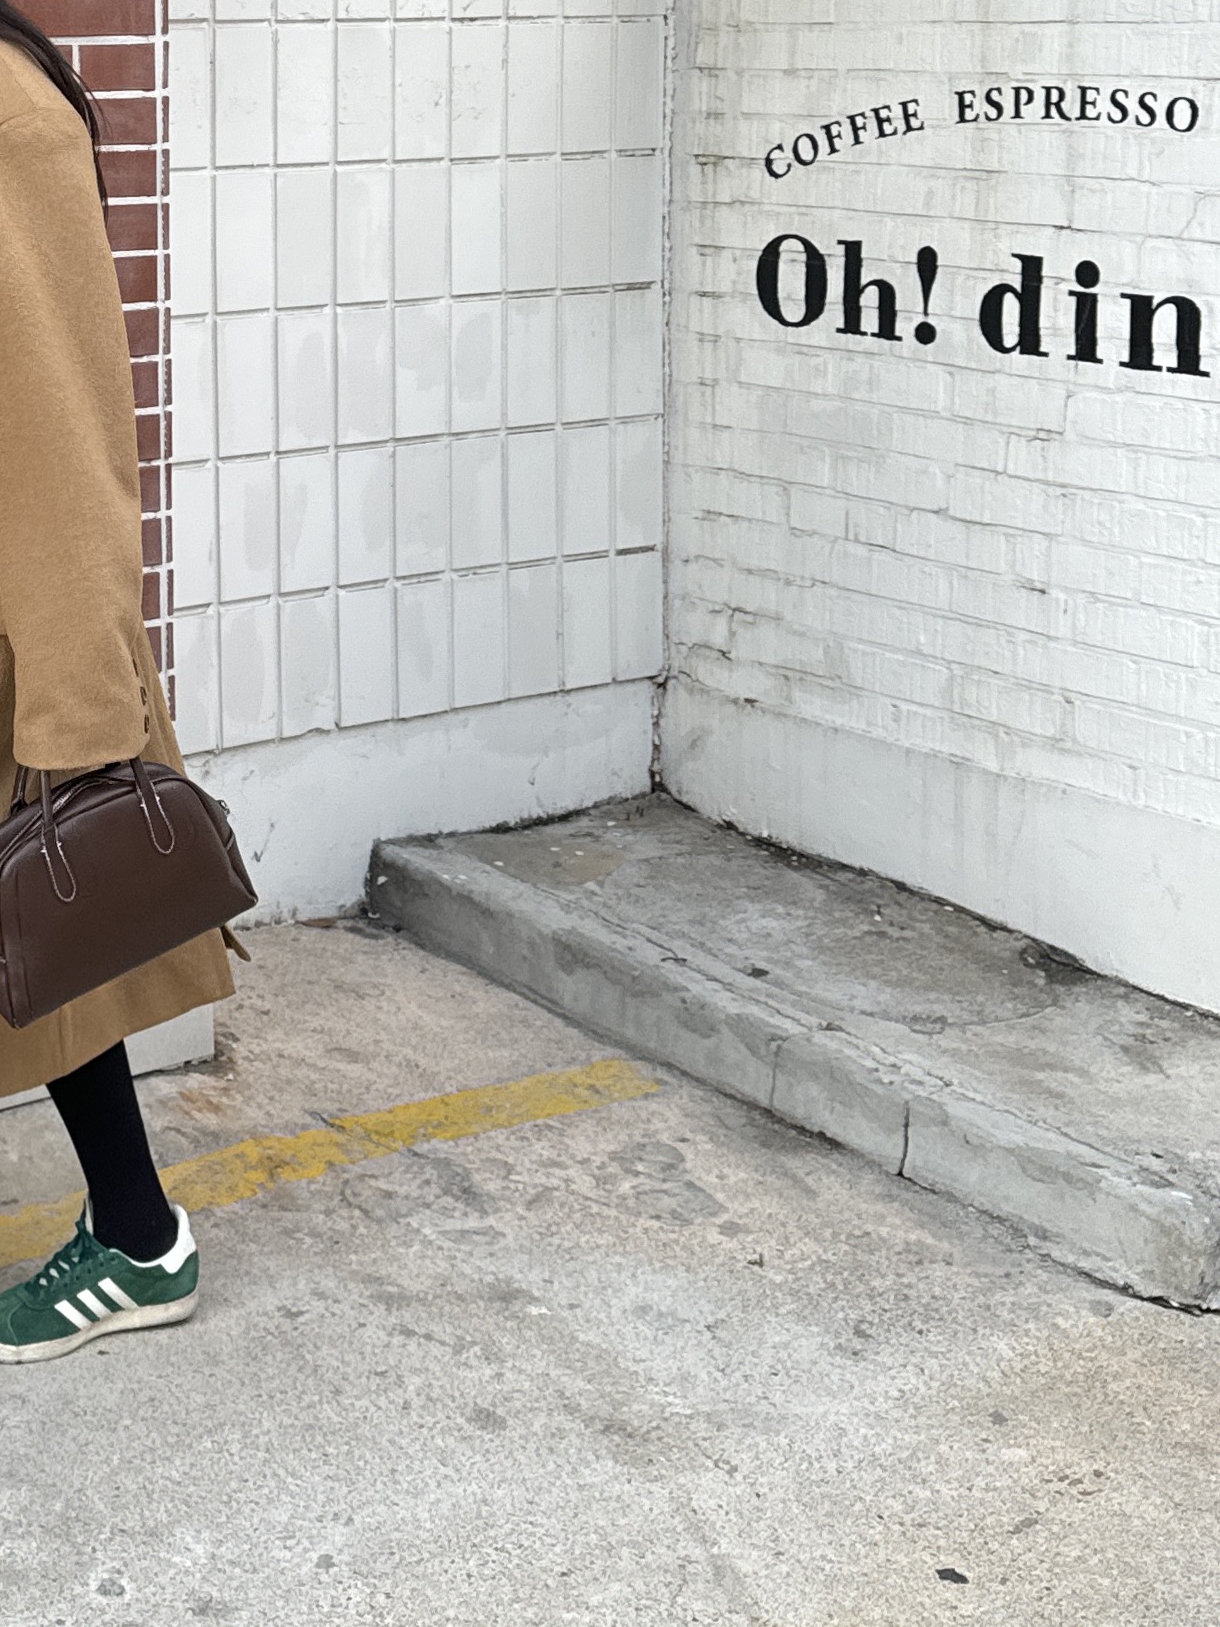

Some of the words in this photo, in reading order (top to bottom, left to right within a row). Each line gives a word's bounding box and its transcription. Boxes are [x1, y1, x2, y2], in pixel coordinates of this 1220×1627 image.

[764, 99, 925, 180] COFFEE
[954, 85, 1200, 133] ESPRESSO
[756, 233, 939, 347] Oh!
[978, 253, 1211, 378] din
